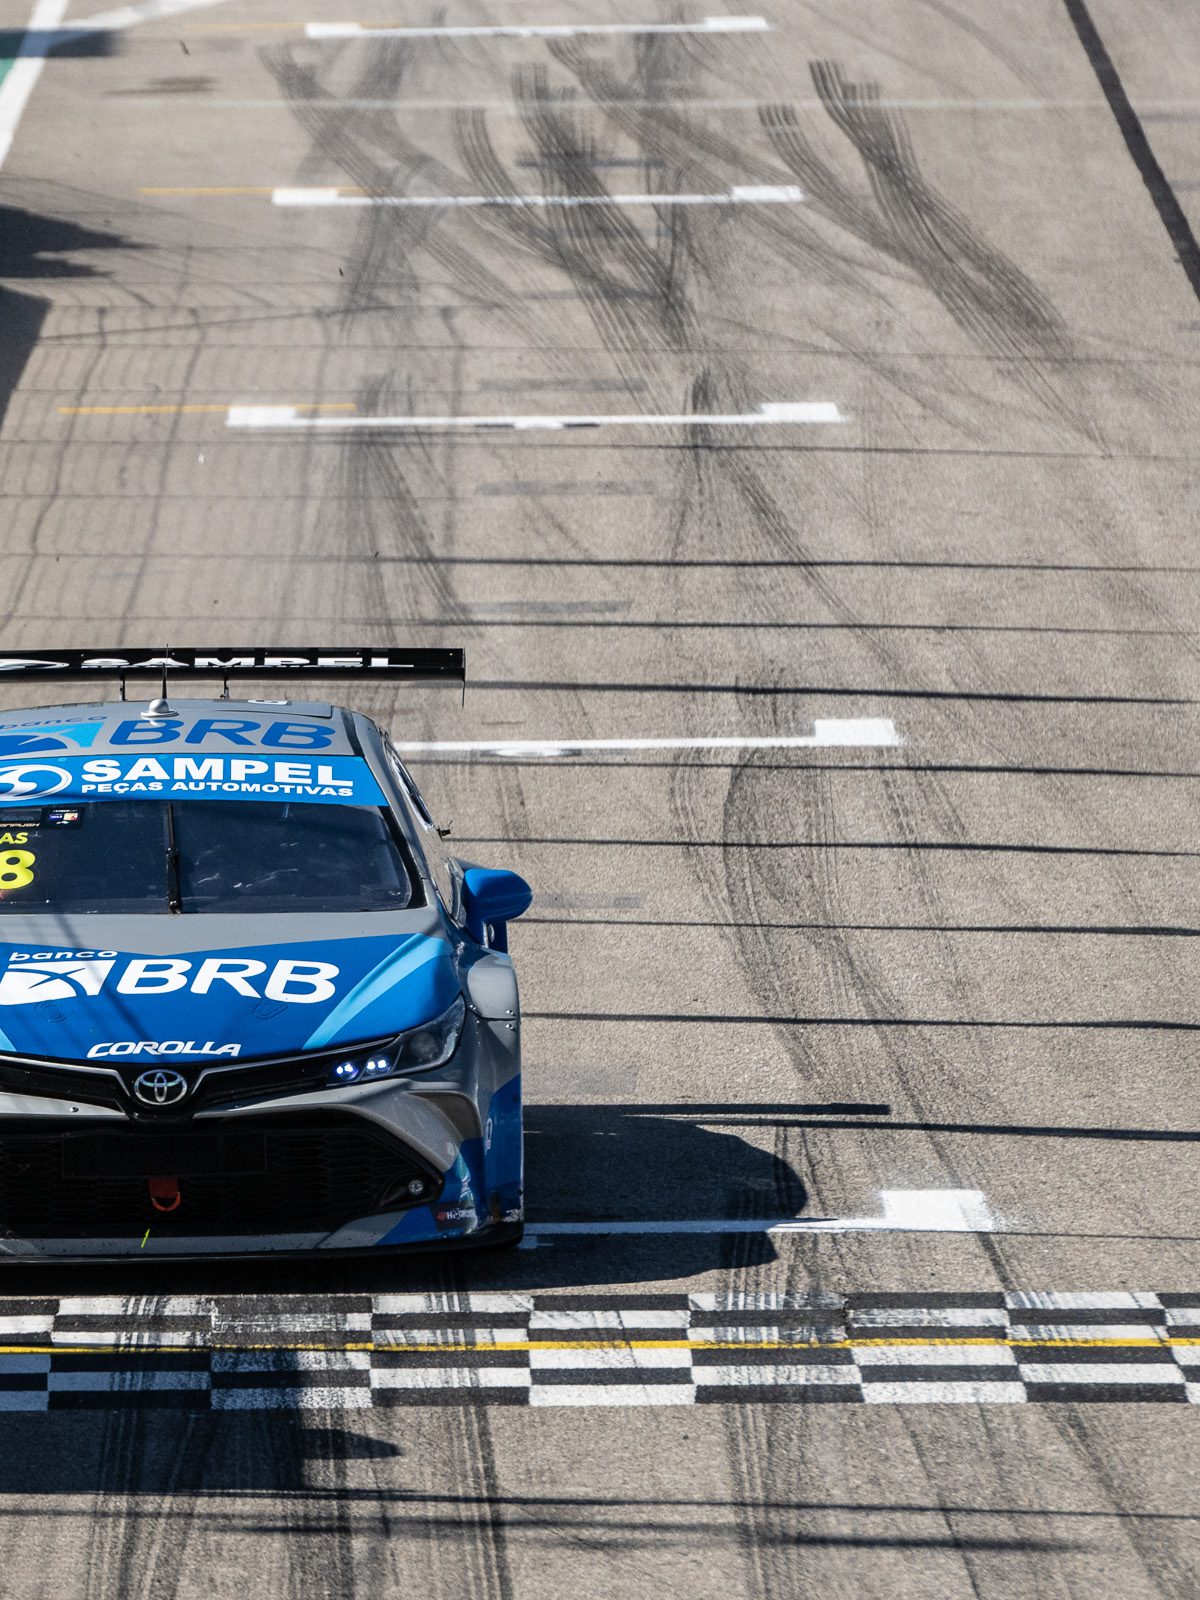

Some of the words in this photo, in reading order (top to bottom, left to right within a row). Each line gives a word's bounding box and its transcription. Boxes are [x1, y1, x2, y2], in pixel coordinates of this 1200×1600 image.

[108, 717, 336, 750] BRB
[81, 757, 354, 787] SAMPEL
[81, 782, 164, 795] PEÇAS
[171, 781, 354, 797] AUTOMOTIVAS
[8, 950, 119, 962] banco
[116, 958, 340, 1004] BRB
[86, 1040, 242, 1058] COROLLA
